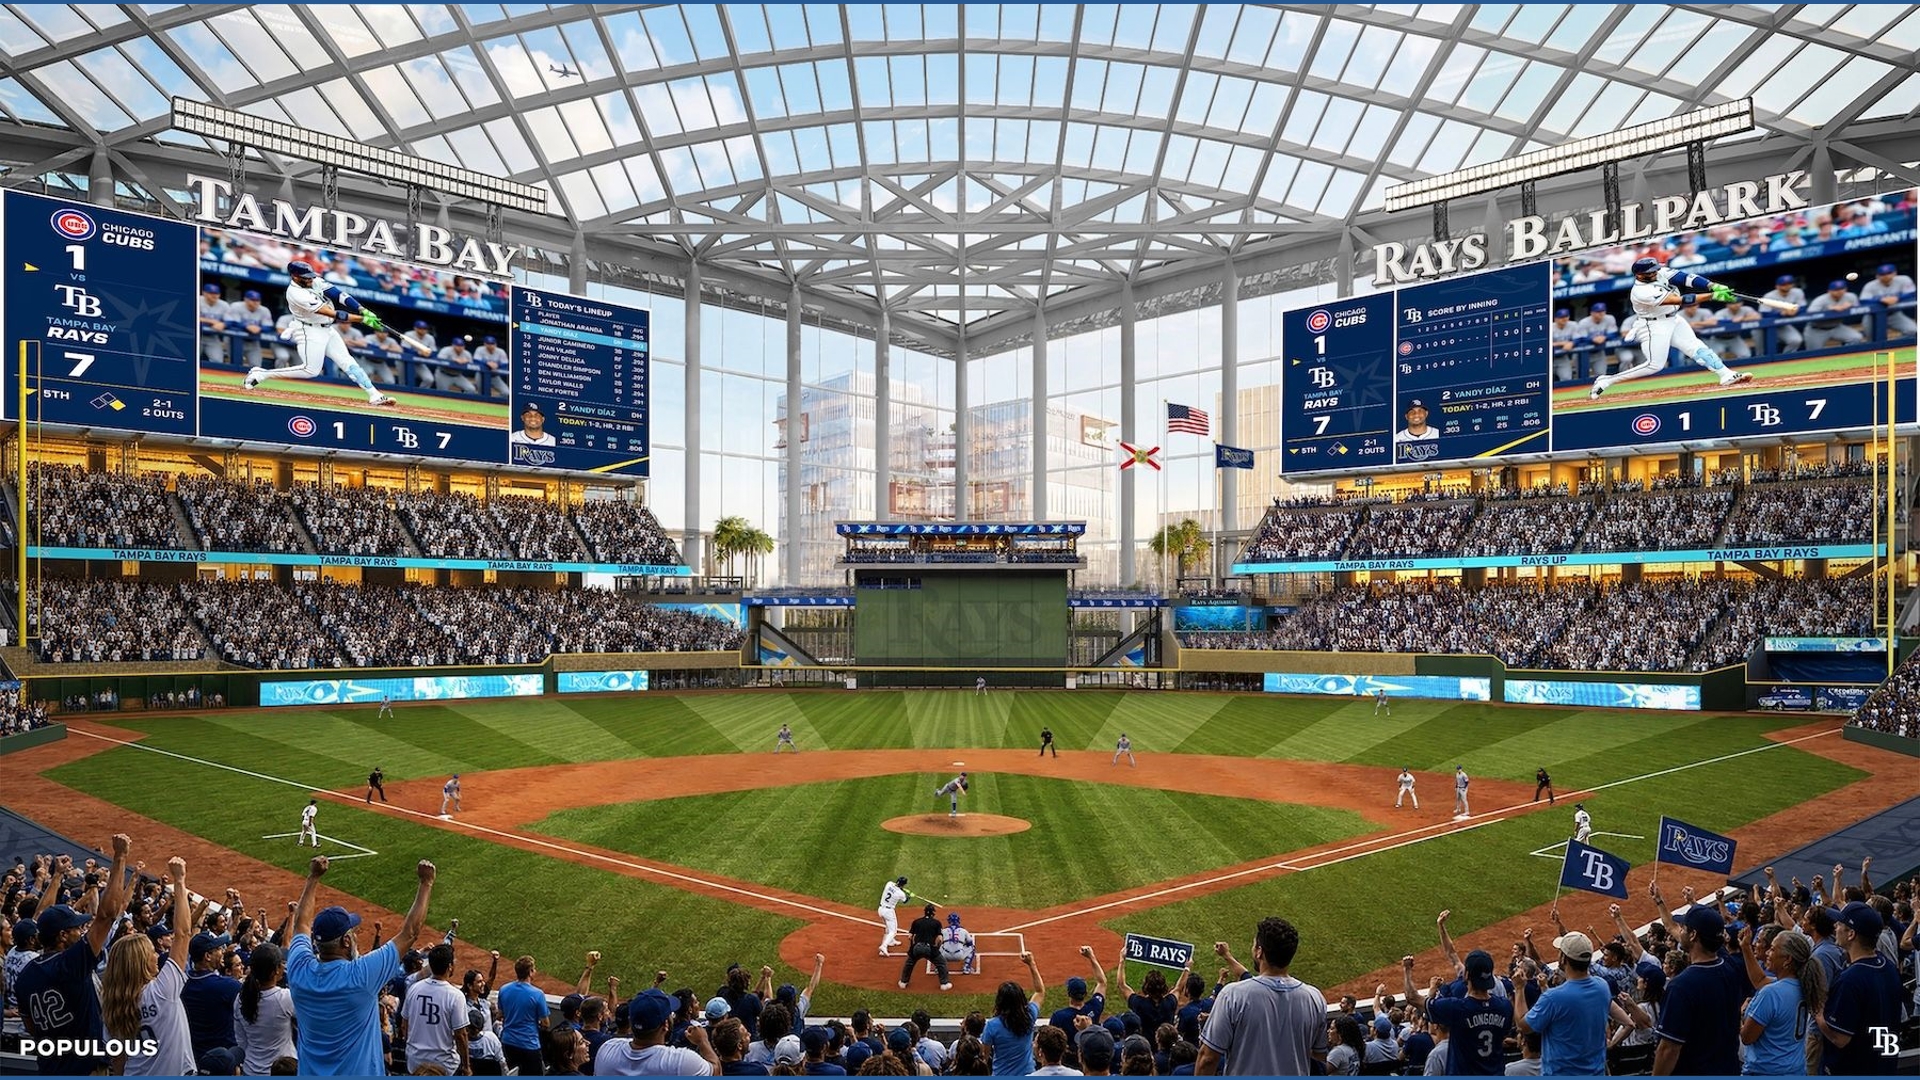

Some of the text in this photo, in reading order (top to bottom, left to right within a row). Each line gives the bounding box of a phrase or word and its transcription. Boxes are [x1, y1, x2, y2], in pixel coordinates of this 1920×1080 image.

[102, 222, 154, 239] CHICAGO
[187, 173, 521, 278] TAMPA BAY
[1372, 171, 1811, 288] RAYS BALLPARK
[102, 232, 155, 251] CUBS
[65, 244, 85, 271] 1
[70, 273, 86, 281] VS
[54, 284, 102, 318] TB
[523, 291, 613, 318] TB TODAY'S LINEUP
[1334, 306, 1367, 319] CHICAGO
[1403, 298, 1498, 323] TB SCORE BY INNING
[46, 316, 117, 333] TAMPA BAY
[540, 318, 576, 329] JONATHAN
[576, 324, 604, 334] ARANDA
[1334, 314, 1367, 328] CUBS
[47, 326, 108, 345] RAYS
[538, 336, 596, 350] JUNIOR CAMINERO
[538, 344, 555, 352] RYAN
[1314, 335, 1326, 355] 1
[64, 351, 95, 377] 7
[538, 353, 586, 365] JONNY DELUCA
[538, 360, 602, 376] CHANDLER SIMPSON
[1399, 363, 1412, 375] TB
[538, 378, 584, 390] TAYLOR WALLS
[552, 371, 592, 382] WILLIAMSON
[1308, 366, 1335, 389] TB
[43, 389, 70, 400] 5TH
[538, 386, 554, 394] NICK
[555, 388, 579, 397] FORTES
[1303, 388, 1344, 400] TAMPA BAY
[1442, 381, 1540, 400] 2 YANDY DÍAZ DH
[153, 399, 172, 409] 2-1
[558, 402, 567, 411] 2
[569, 404, 595, 414] YANDY
[597, 406, 616, 417] DÍAZ
[1303, 397, 1339, 410] RAYS
[1442, 404, 1474, 414] TODAY:
[1475, 403, 1490, 411] 1-2,
[1491, 401, 1506, 409] HR,
[1514, 398, 1529, 406] RBI
[142, 408, 185, 420] 2 OUTS
[1523, 411, 1539, 419] OPS
[1678, 399, 1827, 431] 1 TB 7
[558, 417, 588, 427] TODAY:
[588, 420, 602, 429] 1-2,
[603, 422, 615, 431] HR,
[621, 424, 634, 432] RBI
[1312, 415, 1331, 435] 7
[1443, 426, 1460, 434] .303
[1521, 418, 1540, 427] .806
[333, 421, 452, 450] 1 TB 7
[1364, 438, 1377, 447] 2-1
[513, 444, 556, 466] RAYS
[1301, 446, 1317, 455] 5TH
[1364, 446, 1386, 455] OUTS
[1398, 443, 1439, 461] RAYS
[112, 550, 207, 562] TAMPA BAY RAYS
[319, 556, 398, 567] TAMPA BAY RAYS
[1521, 555, 1567, 565] RAYS UP
[1707, 547, 1819, 560] TAMPA BAY RAYS
[487, 561, 554, 571] TAMPA BAY RAYS
[618, 565, 678, 574] TAMPA BAY RAYS
[1334, 560, 1415, 571] TAMPA BAY RAYS
[1533, 683, 1573, 699] RAYS
[1663, 824, 1729, 864] RAYS
[1580, 849, 1614, 891] TB
[885, 892, 891, 903] 2
[1129, 939, 1187, 964] TB RAYS
[30, 989, 74, 1031] 42
[417, 994, 440, 1025] TB
[1466, 1012, 1506, 1029] LONGORIA
[1477, 1030, 1493, 1058] 3
